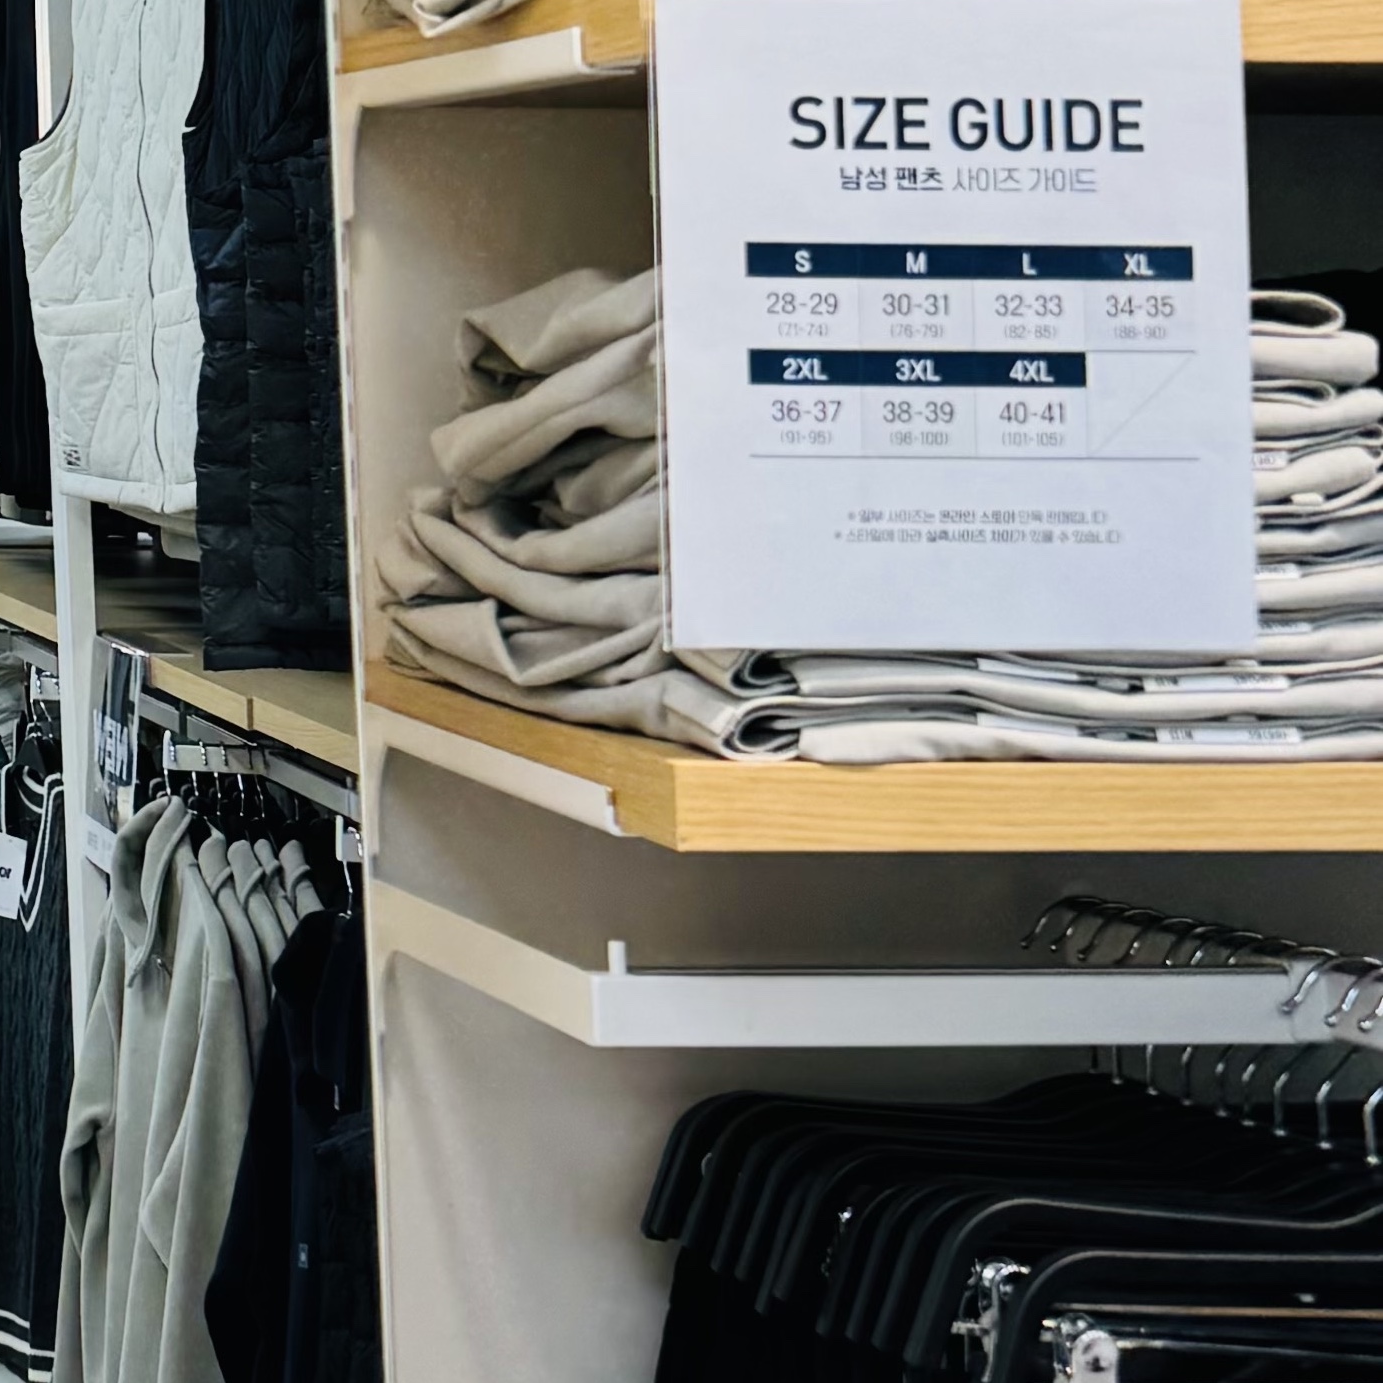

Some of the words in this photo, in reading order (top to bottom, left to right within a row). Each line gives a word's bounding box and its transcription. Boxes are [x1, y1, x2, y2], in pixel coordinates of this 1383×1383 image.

[788, 95, 931, 152] SIZE
[949, 97, 1146, 154] GUIDE
[838, 166, 888, 191] 남성
[893, 166, 945, 191] 팬츠
[951, 167, 1023, 193] 사이즈
[1027, 167, 1099, 193] 가이드
[794, 250, 812, 273] S
[905, 251, 928, 274] M
[1022, 253, 1038, 276] L
[1124, 253, 1154, 276] XL
[766, 292, 838, 315] 28-29
[882, 293, 950, 316] 30-31
[994, 294, 1063, 317] 32-33
[1106, 295, 1175, 318] 34-35
[782, 357, 829, 381] 2XL
[895, 358, 942, 382] 3XL
[1009, 359, 1055, 383] 4XL
[771, 399, 842, 423] 36-37
[882, 400, 955, 424] 38-39
[998, 401, 1067, 425] 40-41
